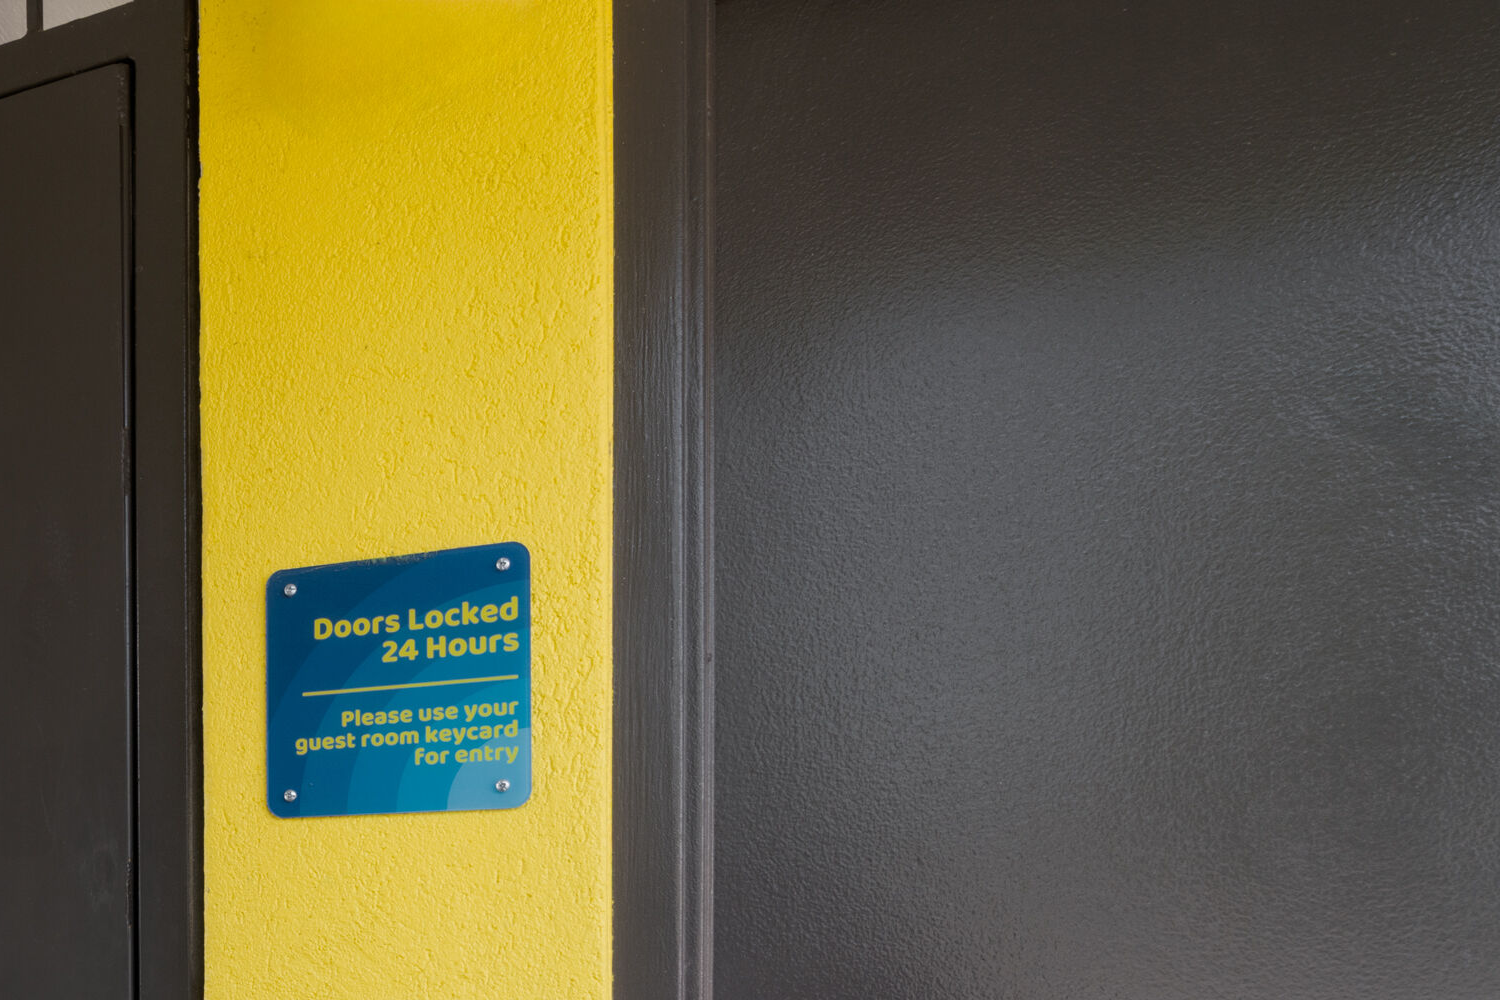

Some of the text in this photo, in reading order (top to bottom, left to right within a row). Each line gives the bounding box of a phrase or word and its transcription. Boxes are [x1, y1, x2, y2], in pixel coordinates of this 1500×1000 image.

[314, 596, 519, 640] Doors Locked
[382, 632, 519, 663] 24 Hours
[341, 701, 519, 727] Please use your
[295, 719, 518, 755] guest room keycard
[414, 746, 519, 765] for entry
